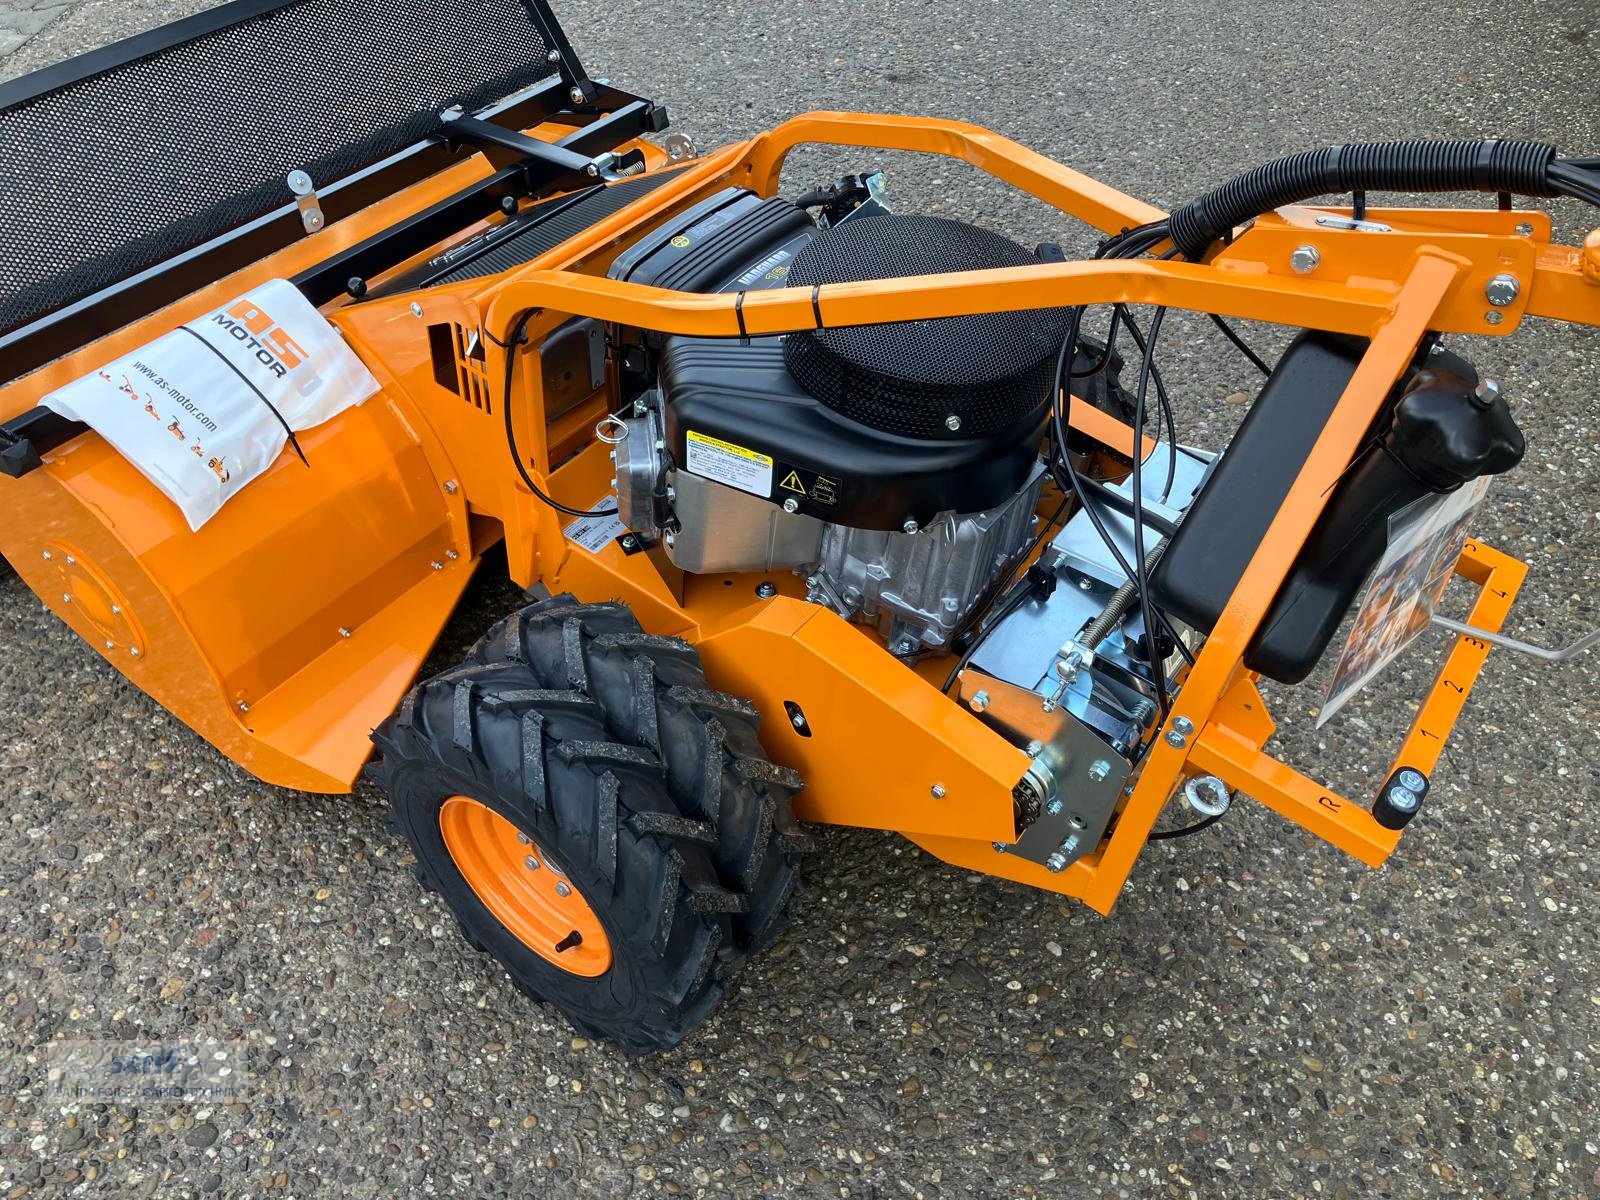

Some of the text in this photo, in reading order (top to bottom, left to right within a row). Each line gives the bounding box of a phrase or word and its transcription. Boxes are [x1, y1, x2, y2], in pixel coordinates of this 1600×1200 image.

[211, 314, 287, 378] MOTOR
[133, 361, 218, 432] www.as-motor.com
[1490, 588, 1509, 598] 4
[1464, 637, 1484, 650] 3
[1443, 680, 1464, 693] 2
[1420, 729, 1440, 740] 1
[1318, 796, 1341, 814] R
